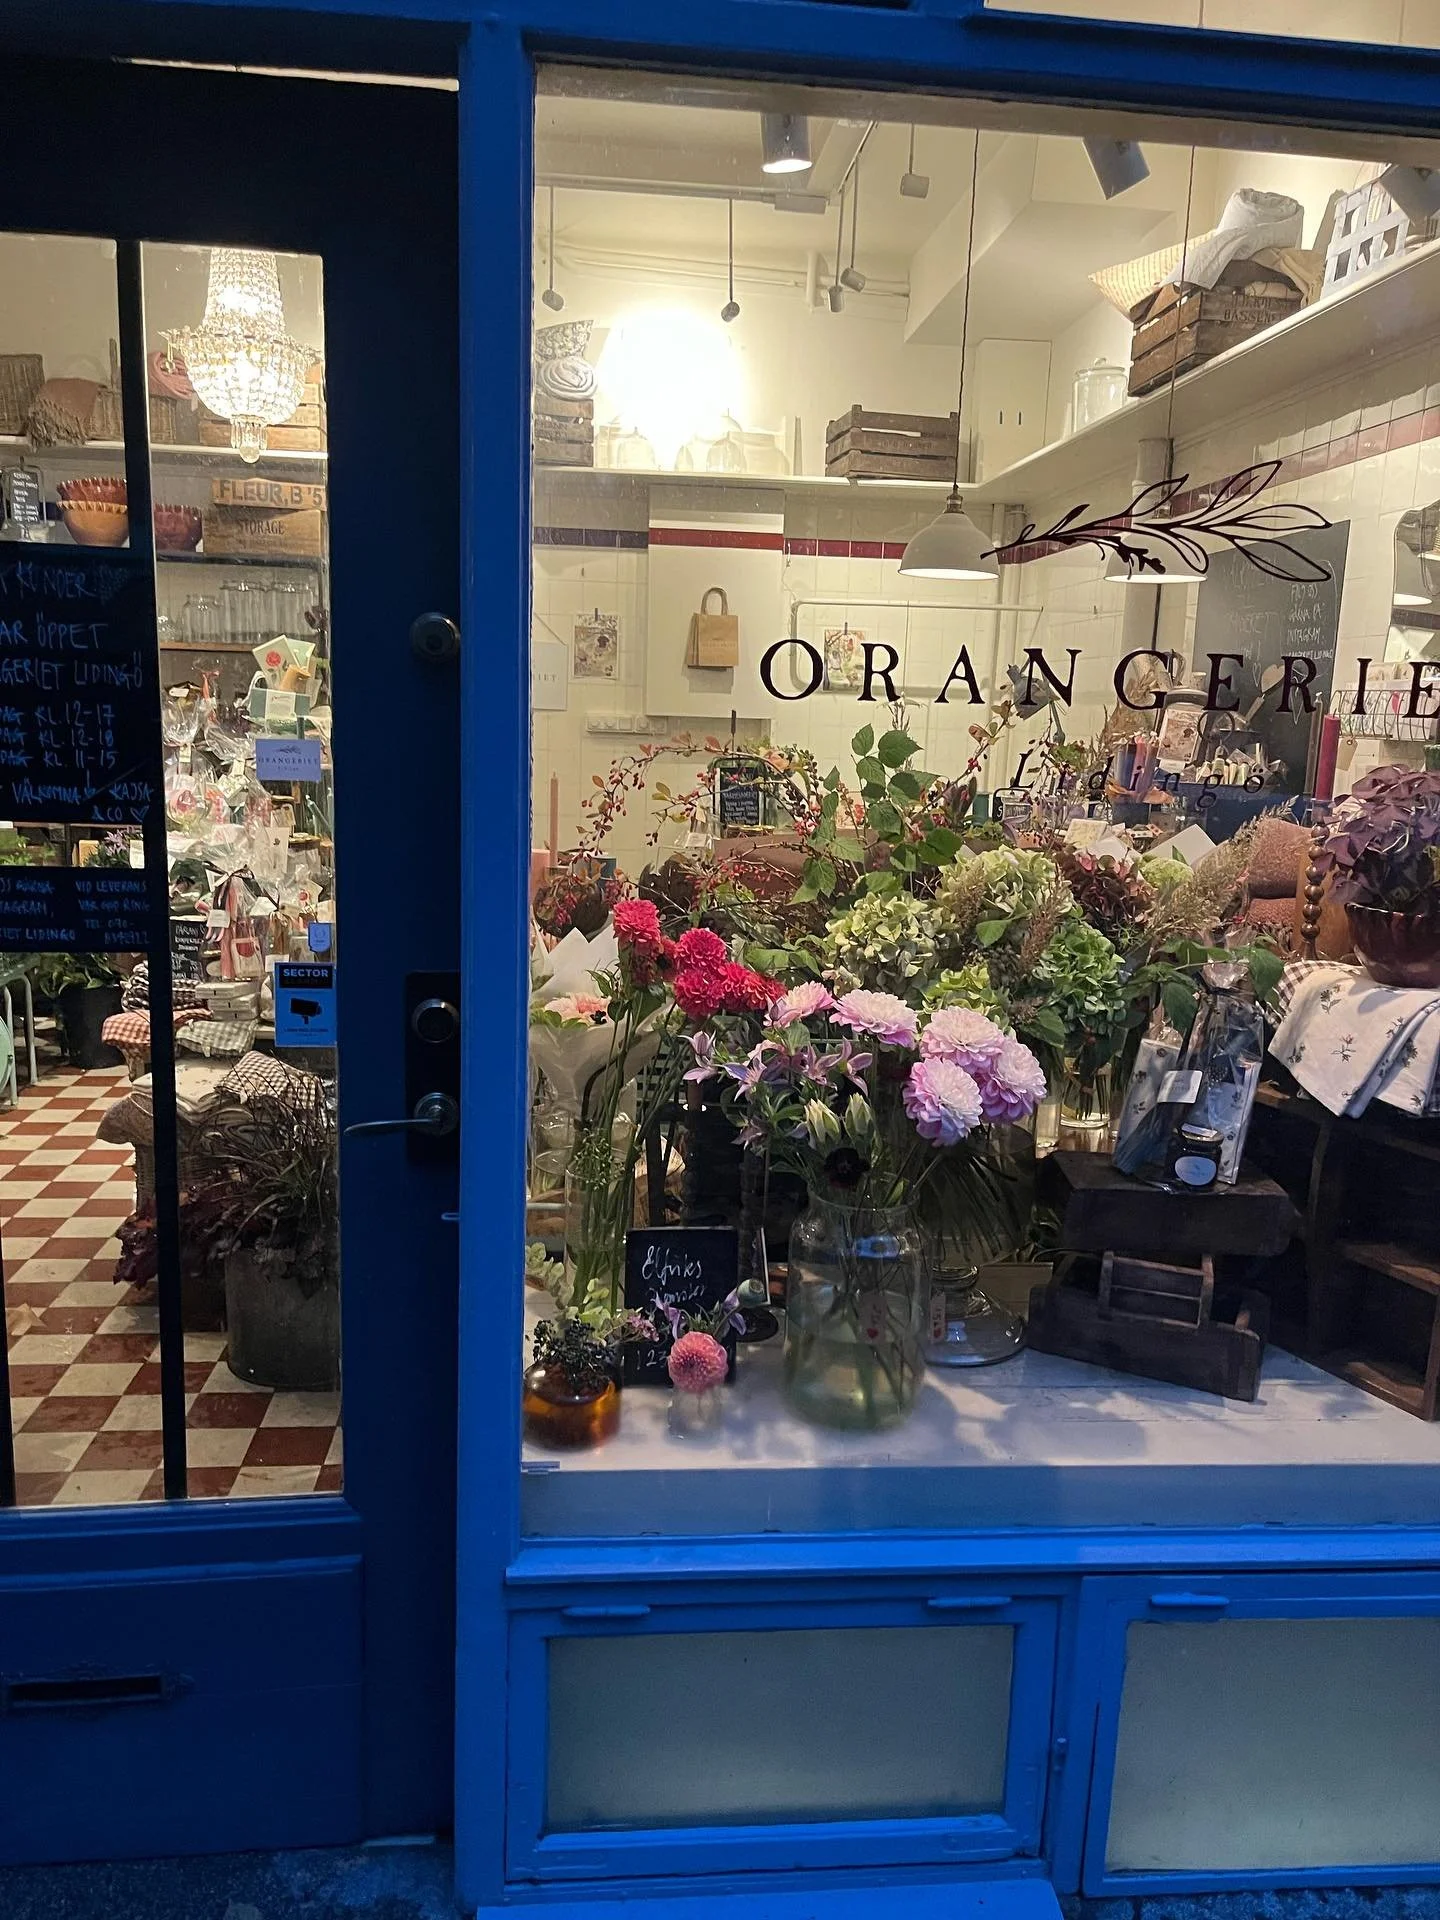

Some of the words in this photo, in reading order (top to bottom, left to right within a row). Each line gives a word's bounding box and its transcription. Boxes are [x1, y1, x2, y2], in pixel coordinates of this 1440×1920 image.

[238, 519, 285, 534] STORAGE
[36, 611, 108, 649] ÖPPET
[74, 651, 143, 691] LIDINGÖ
[760, 639, 1440, 720] ORANGERIE
[283, 968, 329, 978] SECTOR
